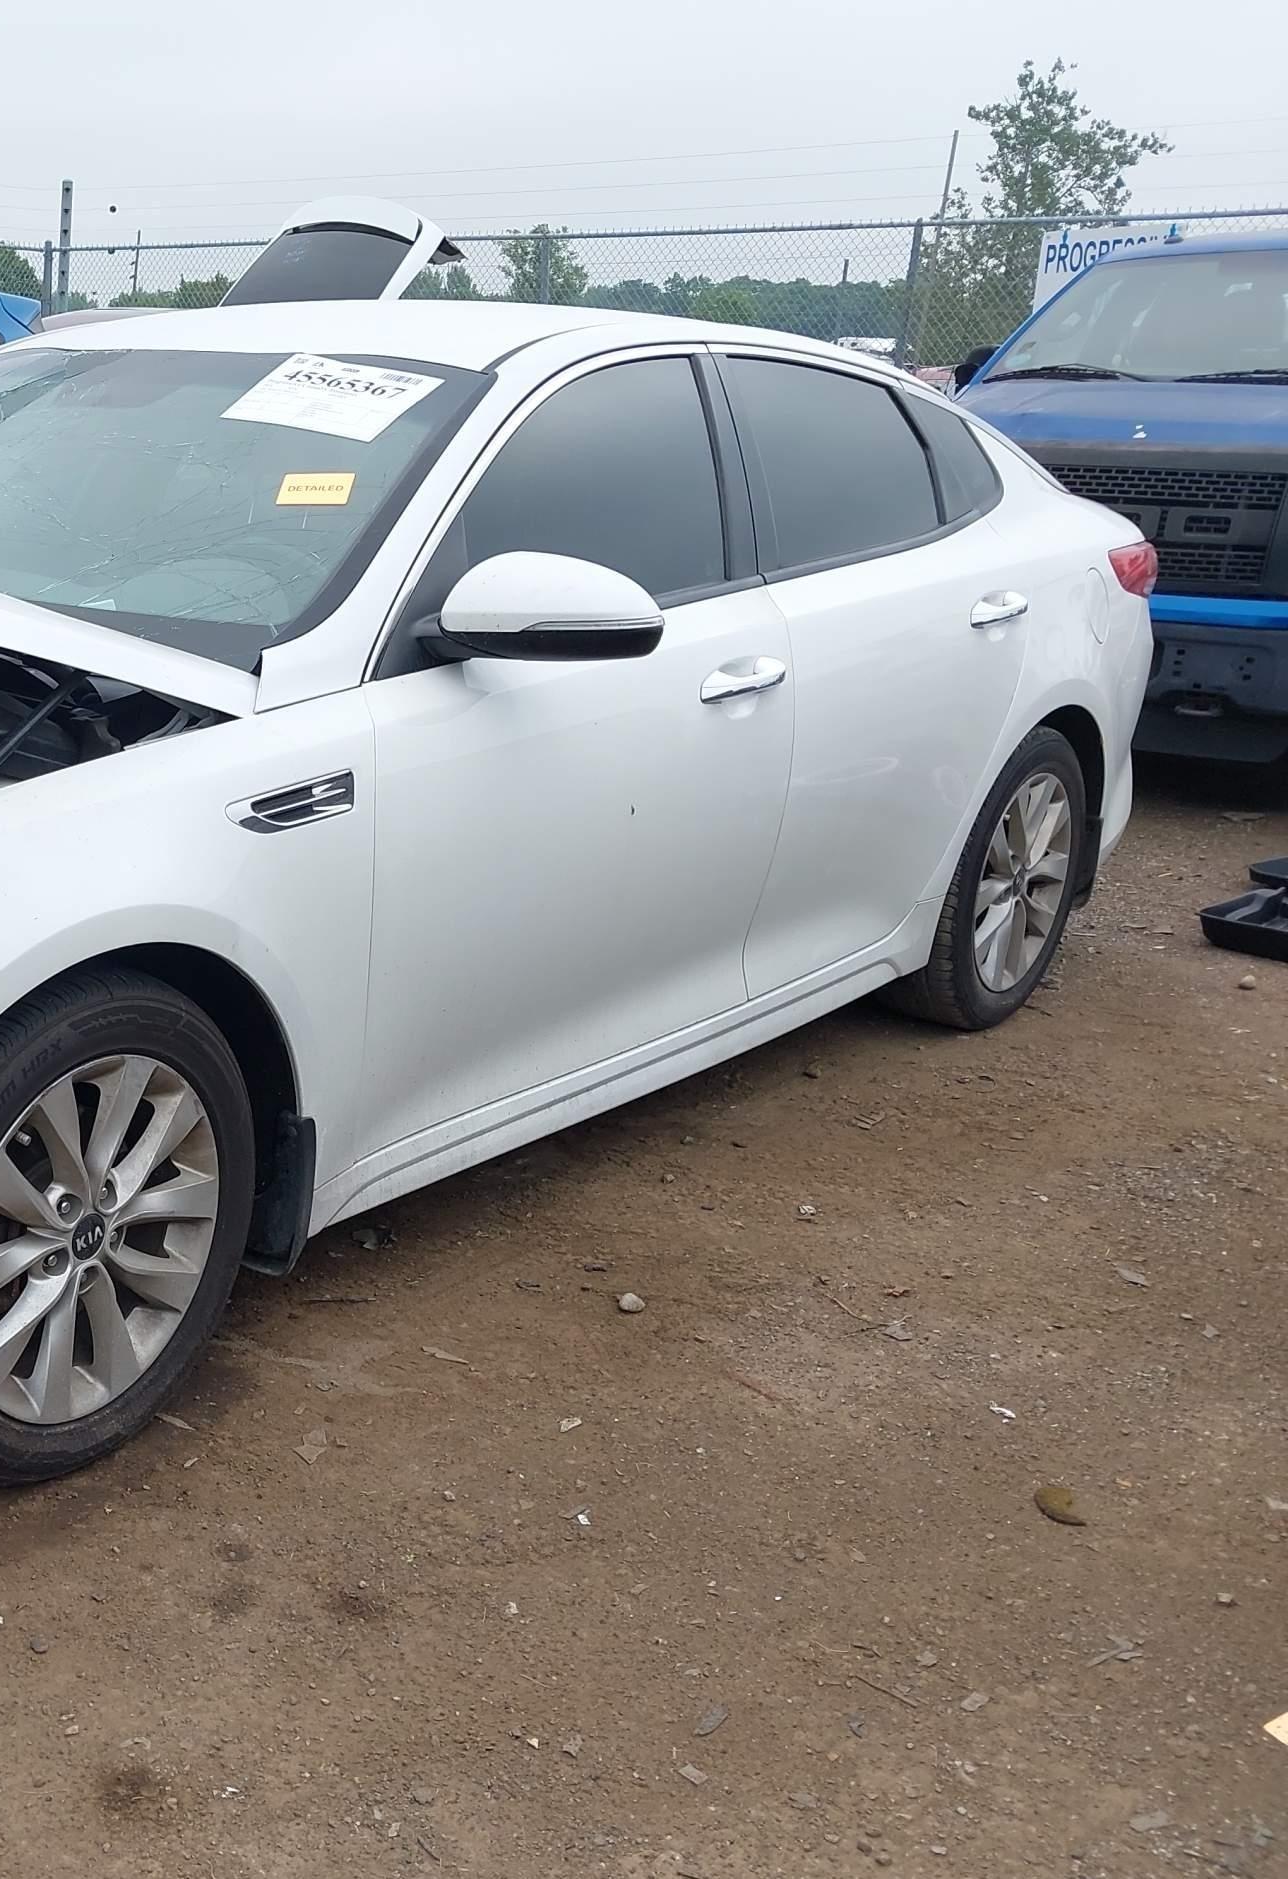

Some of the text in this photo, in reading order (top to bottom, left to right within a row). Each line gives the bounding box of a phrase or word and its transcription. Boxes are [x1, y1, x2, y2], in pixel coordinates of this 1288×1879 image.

[284, 369, 408, 400] 45565367
[287, 484, 344, 493] DETAILED
[75, 1225, 104, 1252] KIA
